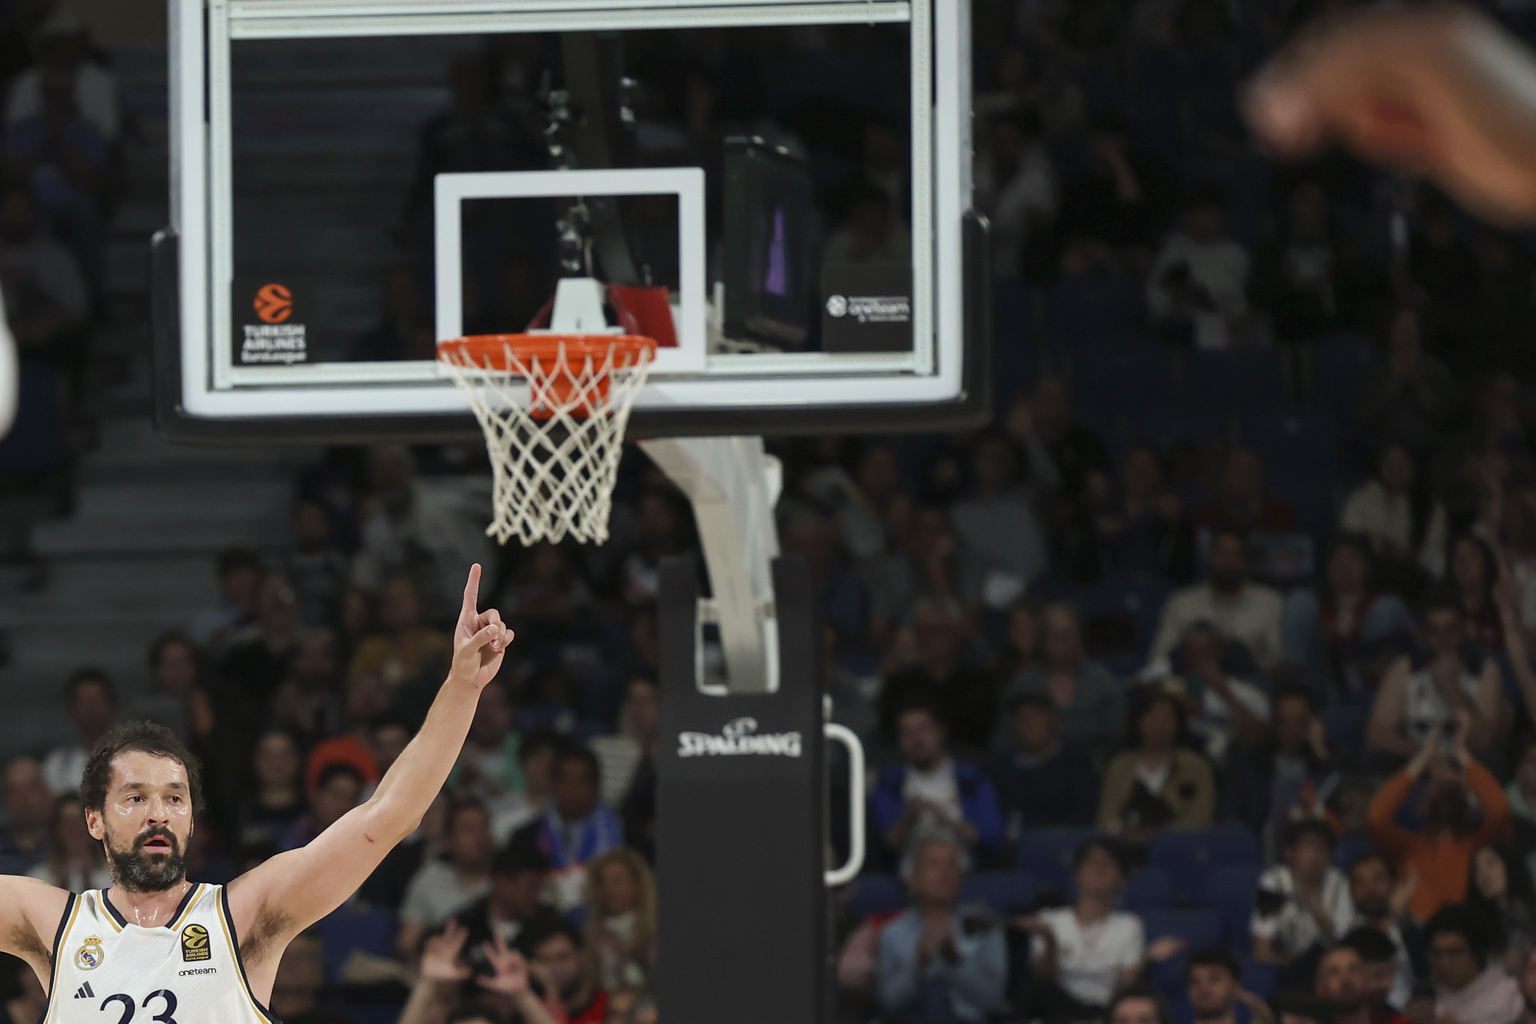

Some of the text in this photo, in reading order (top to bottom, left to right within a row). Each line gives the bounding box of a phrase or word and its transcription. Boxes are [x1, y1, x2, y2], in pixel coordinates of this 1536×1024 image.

[243, 324, 306, 337] TURKISH
[242, 338, 307, 350] AIRLINES
[678, 717, 802, 757] SPALDING
[178, 967, 217, 977] oneteam
